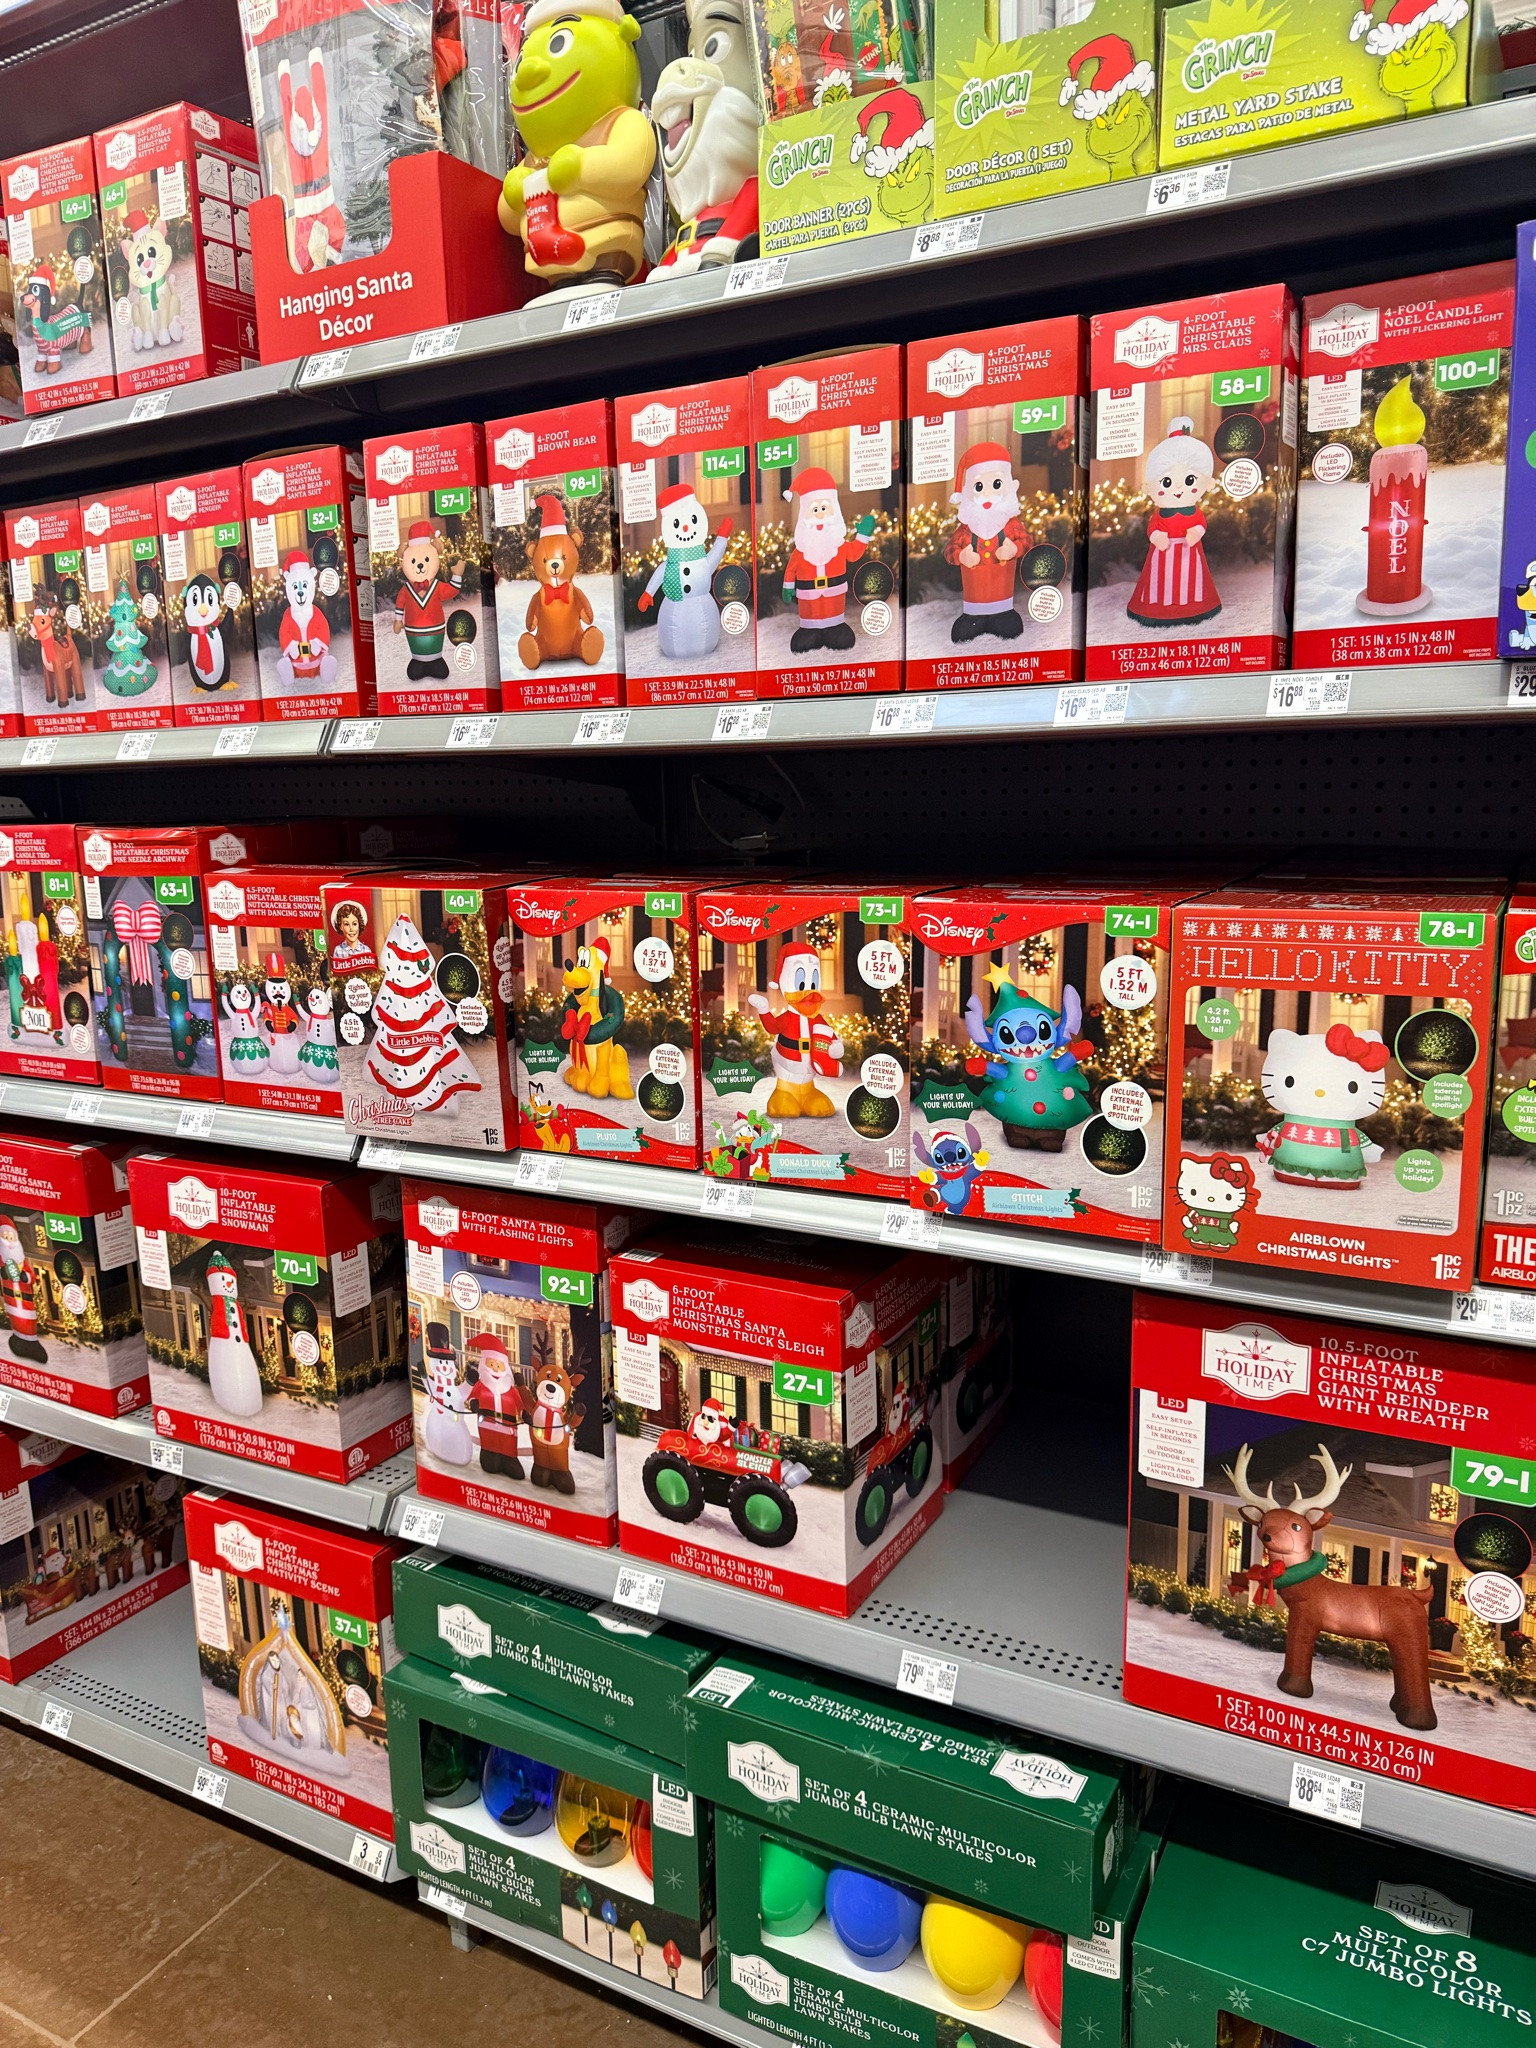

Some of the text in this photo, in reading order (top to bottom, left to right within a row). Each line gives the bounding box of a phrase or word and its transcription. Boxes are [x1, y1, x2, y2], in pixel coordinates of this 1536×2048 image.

[1197, 38, 1213, 52] The
[857, 43, 883, 71] STUNK!
[1184, 32, 1272, 90] GRINCH
[964, 81, 979, 92] The
[956, 72, 1030, 126] GRINCH
[1174, 77, 1343, 130] METAL YARD STAKE
[1174, 99, 1354, 148] ESTACAS PARA PATIO DE METAL
[767, 136, 834, 186] GRINCH
[945, 139, 1073, 181] DOOR DÉCOR (1 SET)
[945, 175, 983, 193] DECORACIÓN
[984, 172, 1000, 186] PARA
[1001, 171, 1009, 182] LA
[1011, 164, 1034, 180] PUERTA
[1043, 158, 1066, 172] JUEGO)
[764, 196, 872, 237] DOOR BANNER (2PCS)
[764, 219, 868, 252] CARTEL PARA PUERTA (2PCS)
[279, 283, 354, 319] Hanging
[356, 269, 414, 298] Santa
[1384, 300, 1437, 317] 4-FOOT
[1384, 303, 1484, 329] NOEL CANDLE
[318, 312, 374, 341] Décor
[1183, 311, 1227, 326] 4-FOOT
[1183, 316, 1256, 335] INFLATABLE
[1384, 313, 1504, 338] WITH FLICKERING LIGHT
[1182, 327, 1252, 345] CHRISTMAS
[1182, 336, 1252, 355] MRS. CLAUS
[987, 344, 1026, 357] 4-FOOT
[987, 349, 1052, 366] INFLATABLE
[1122, 341, 1170, 358] HOLIDAY
[1133, 351, 1158, 363] TIME
[987, 359, 1049, 375] CHRISTMAS
[987, 373, 1022, 385] SANTA
[537, 429, 569, 444] 4-FOOT
[537, 435, 597, 453] BROWN BEAR
[1319, 452, 1345, 462] Includes
[1318, 463, 1346, 474] Flickering
[1322, 469, 1341, 478] Flame
[1387, 500, 1409, 575] NOEL
[332, 956, 376, 969] Little Debbie
[1191, 945, 1471, 988] HELLO KITTY
[1116, 967, 1143, 981] 5 FT
[1118, 992, 1135, 1001] TALL
[1137, 982, 1148, 993] M
[1206, 1007, 1230, 1016] 4.2 ft
[1210, 1024, 1224, 1033] tall
[390, 1034, 439, 1047] Little Debbie
[922, 1101, 974, 1110] YOUR HOLIDAY!
[929, 1093, 965, 1102] LIGHTS UP
[596, 1131, 618, 1142] PLUTO
[779, 1157, 832, 1169] DONALD DUCK
[1010, 1192, 1043, 1204] STITCH
[461, 1211, 566, 1235] 6-FOOT SANTA TRIO
[461, 1221, 574, 1248] WITH FLASHING LIGHTS
[1289, 1231, 1365, 1251] AIRBLOWN
[1257, 1242, 1338, 1265] CHRISTMAS
[1493, 1233, 1536, 1266] THE
[1320, 1337, 1419, 1363] 10.5-FOOT
[1216, 1359, 1294, 1384] HOLIDAY
[1319, 1352, 1444, 1382] INFLATABLE
[1234, 1376, 1275, 1392] TIME
[1318, 1367, 1437, 1396] CHRISTMAS
[1318, 1381, 1489, 1420] GIANT REINDEER
[1317, 1395, 1467, 1432] WITH WREATH
[736, 1451, 773, 1466] MONSTER
[736, 1460, 771, 1473] SLEIGH
[804, 1778, 1037, 1867] SET OF 4 CERAMIC-MULTICOLOR
[804, 1789, 993, 1863] JUMBO BULB LAWN STAKES
[1359, 1925, 1477, 1972] SET OF 8
[1332, 1932, 1503, 1999] MULTICOLOR
[1302, 1937, 1533, 2026] C7 JUMBO LIGHTS
